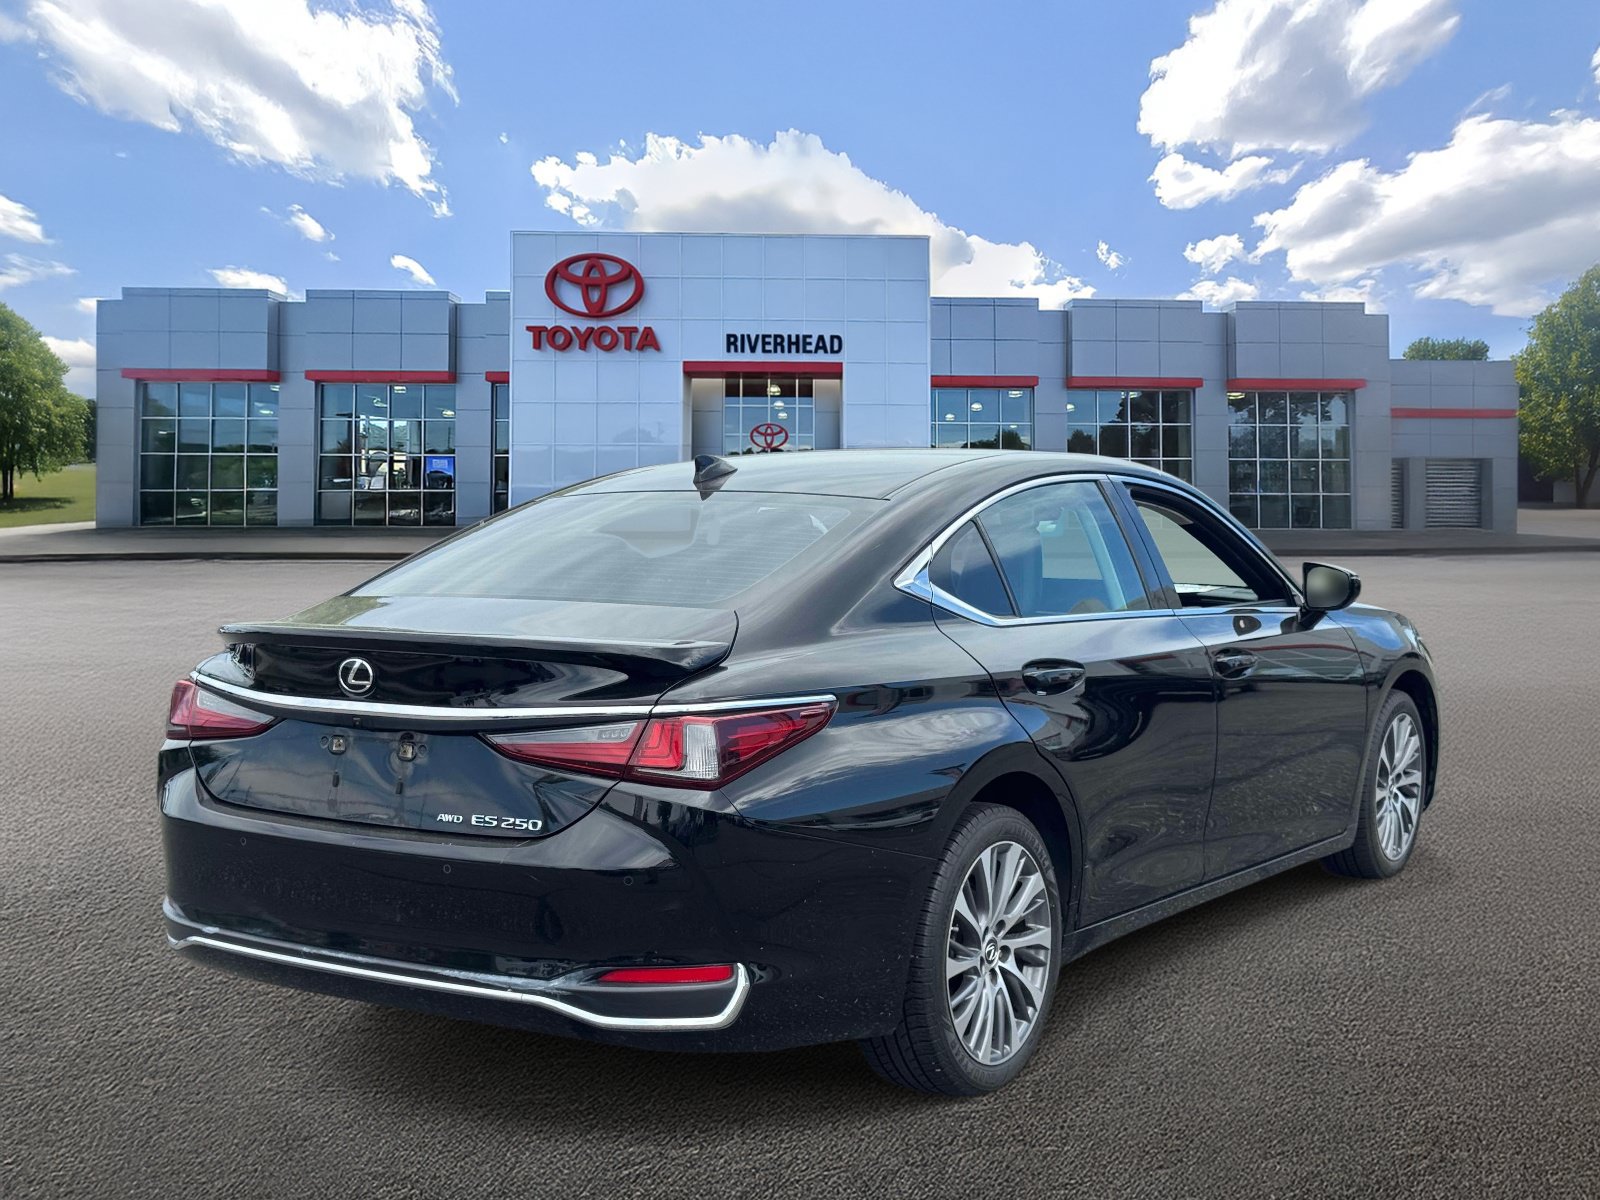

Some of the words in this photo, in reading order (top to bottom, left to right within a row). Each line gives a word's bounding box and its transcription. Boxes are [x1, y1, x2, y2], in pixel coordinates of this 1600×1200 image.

[525, 325, 661, 352] TOYOTA
[726, 333, 843, 354] RIVERHEAD
[437, 813, 463, 823] AWD
[471, 814, 498, 827] ES
[500, 816, 543, 831] 250
